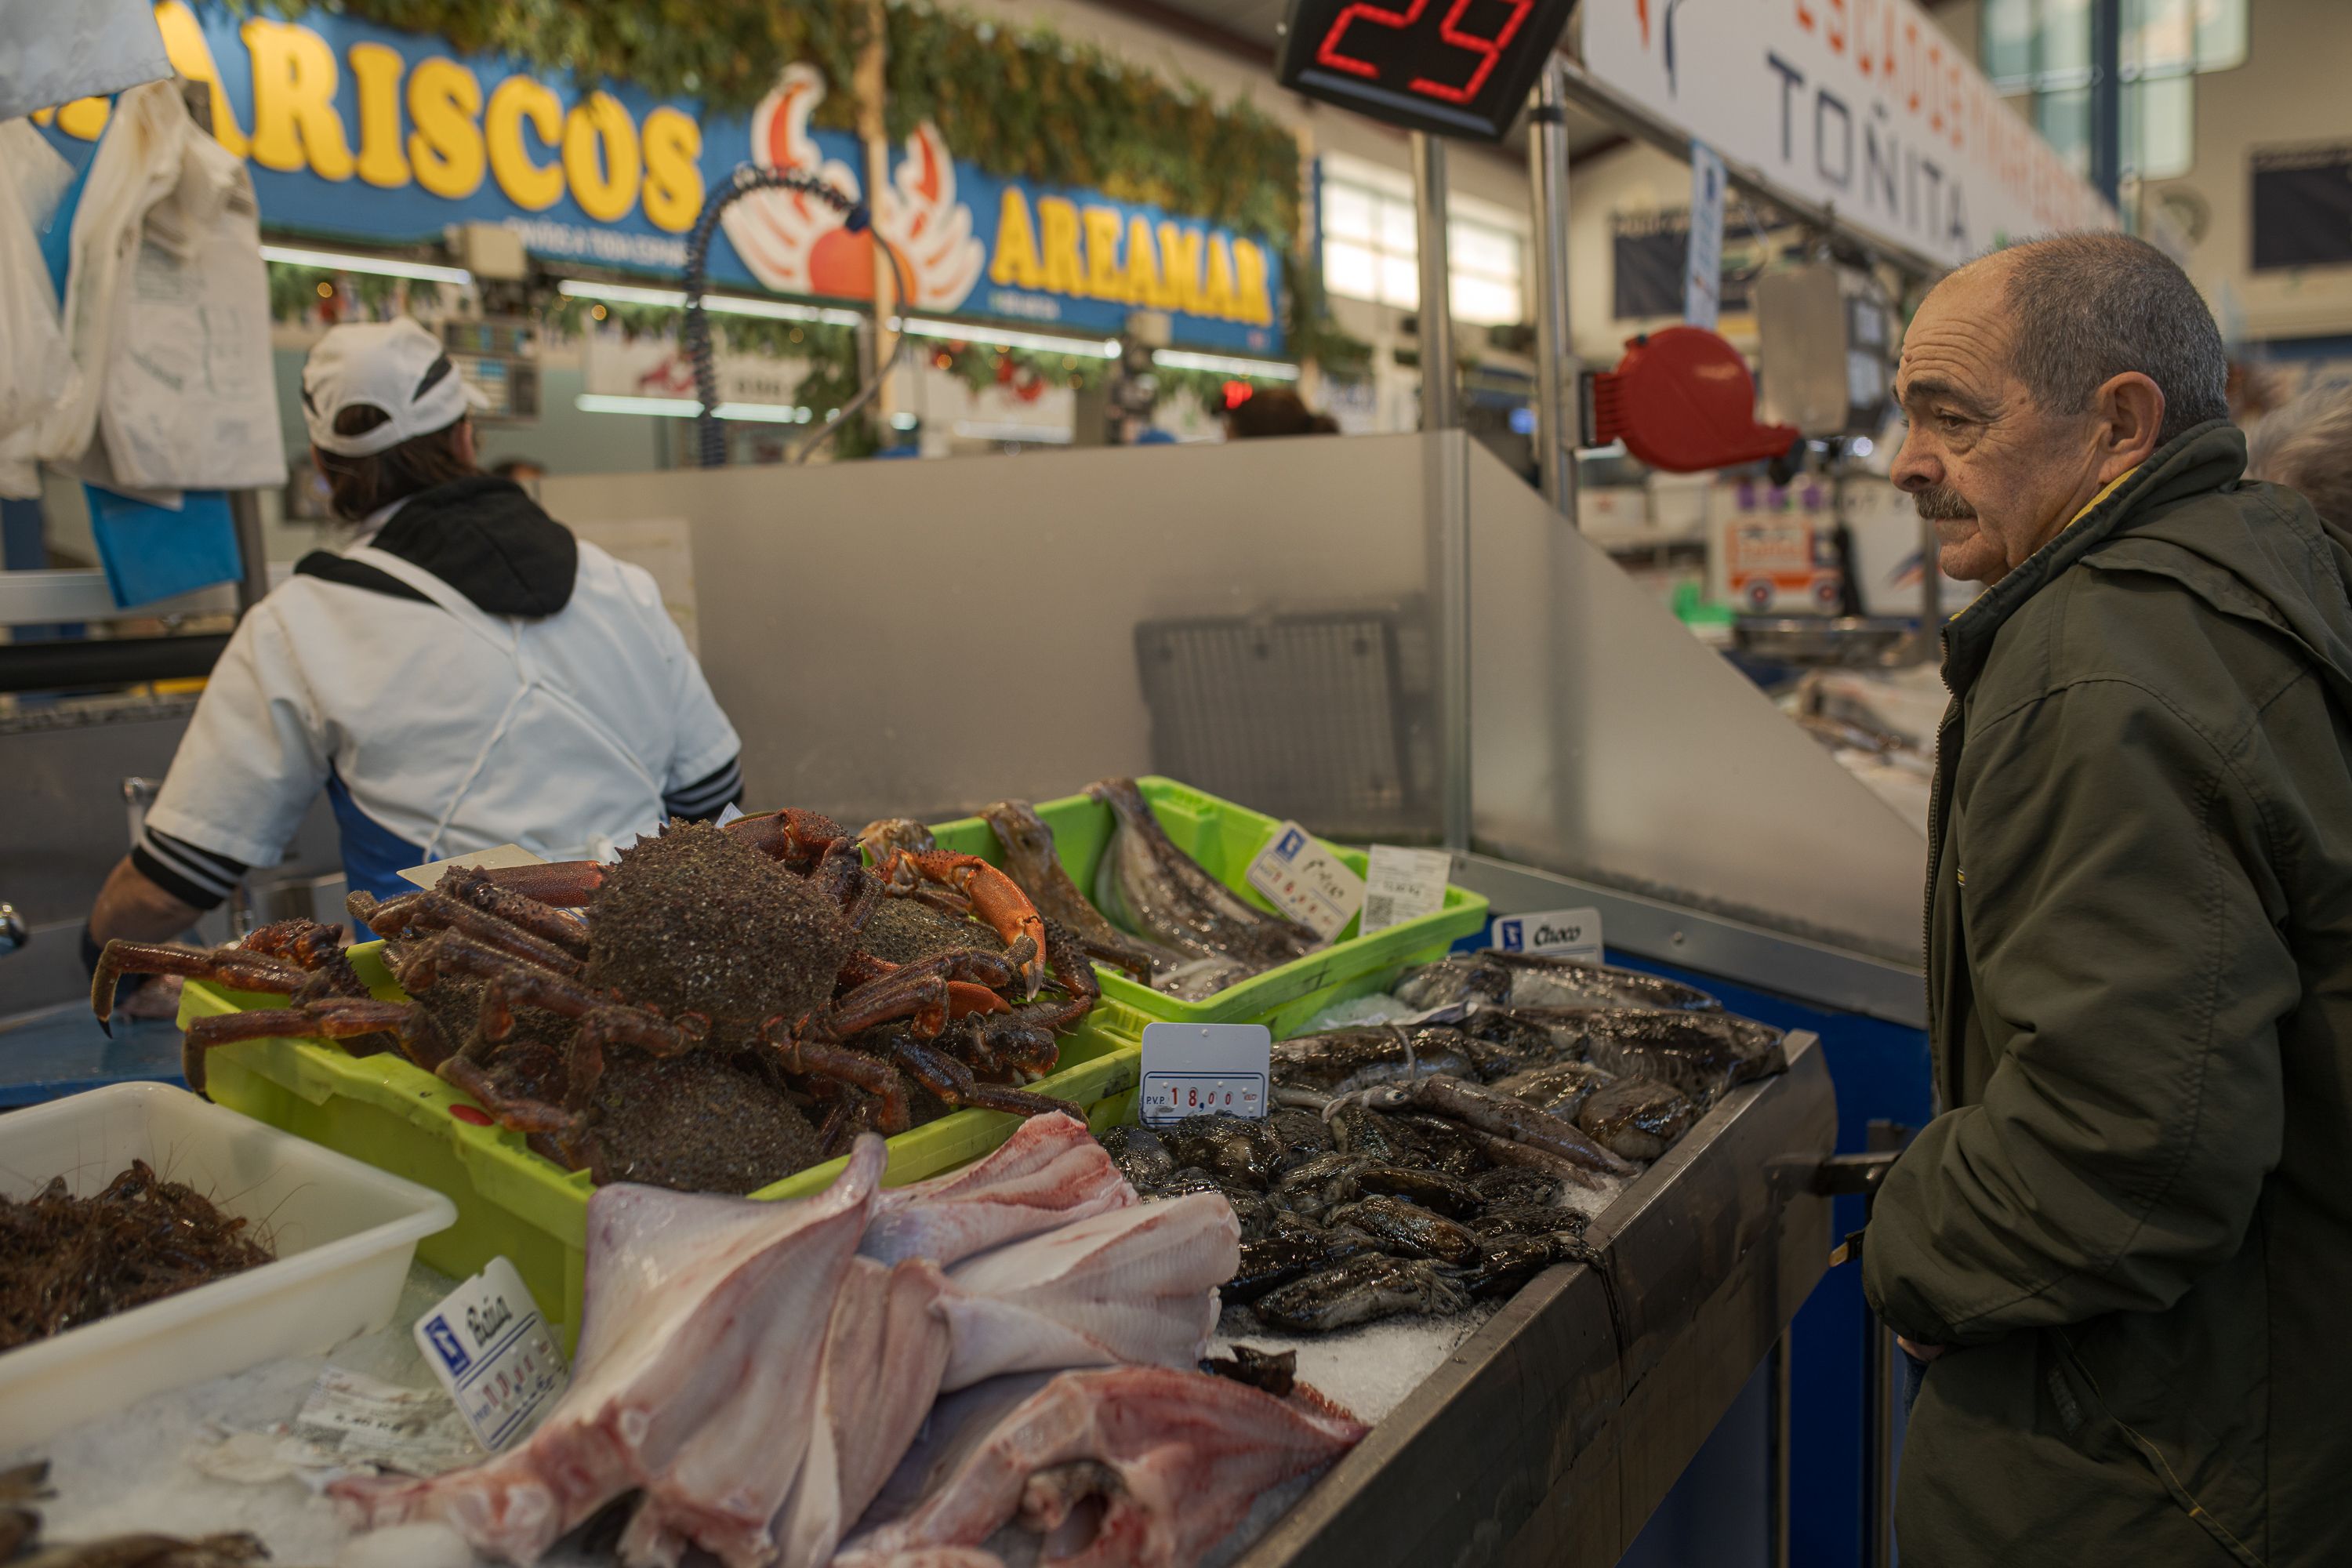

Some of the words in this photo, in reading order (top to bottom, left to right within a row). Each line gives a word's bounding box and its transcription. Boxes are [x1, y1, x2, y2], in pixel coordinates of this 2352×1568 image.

[1766, 50, 1971, 249] TOÑITA
[989, 186, 1273, 328] AREAMAR
[1534, 924, 1581, 946] Choco
